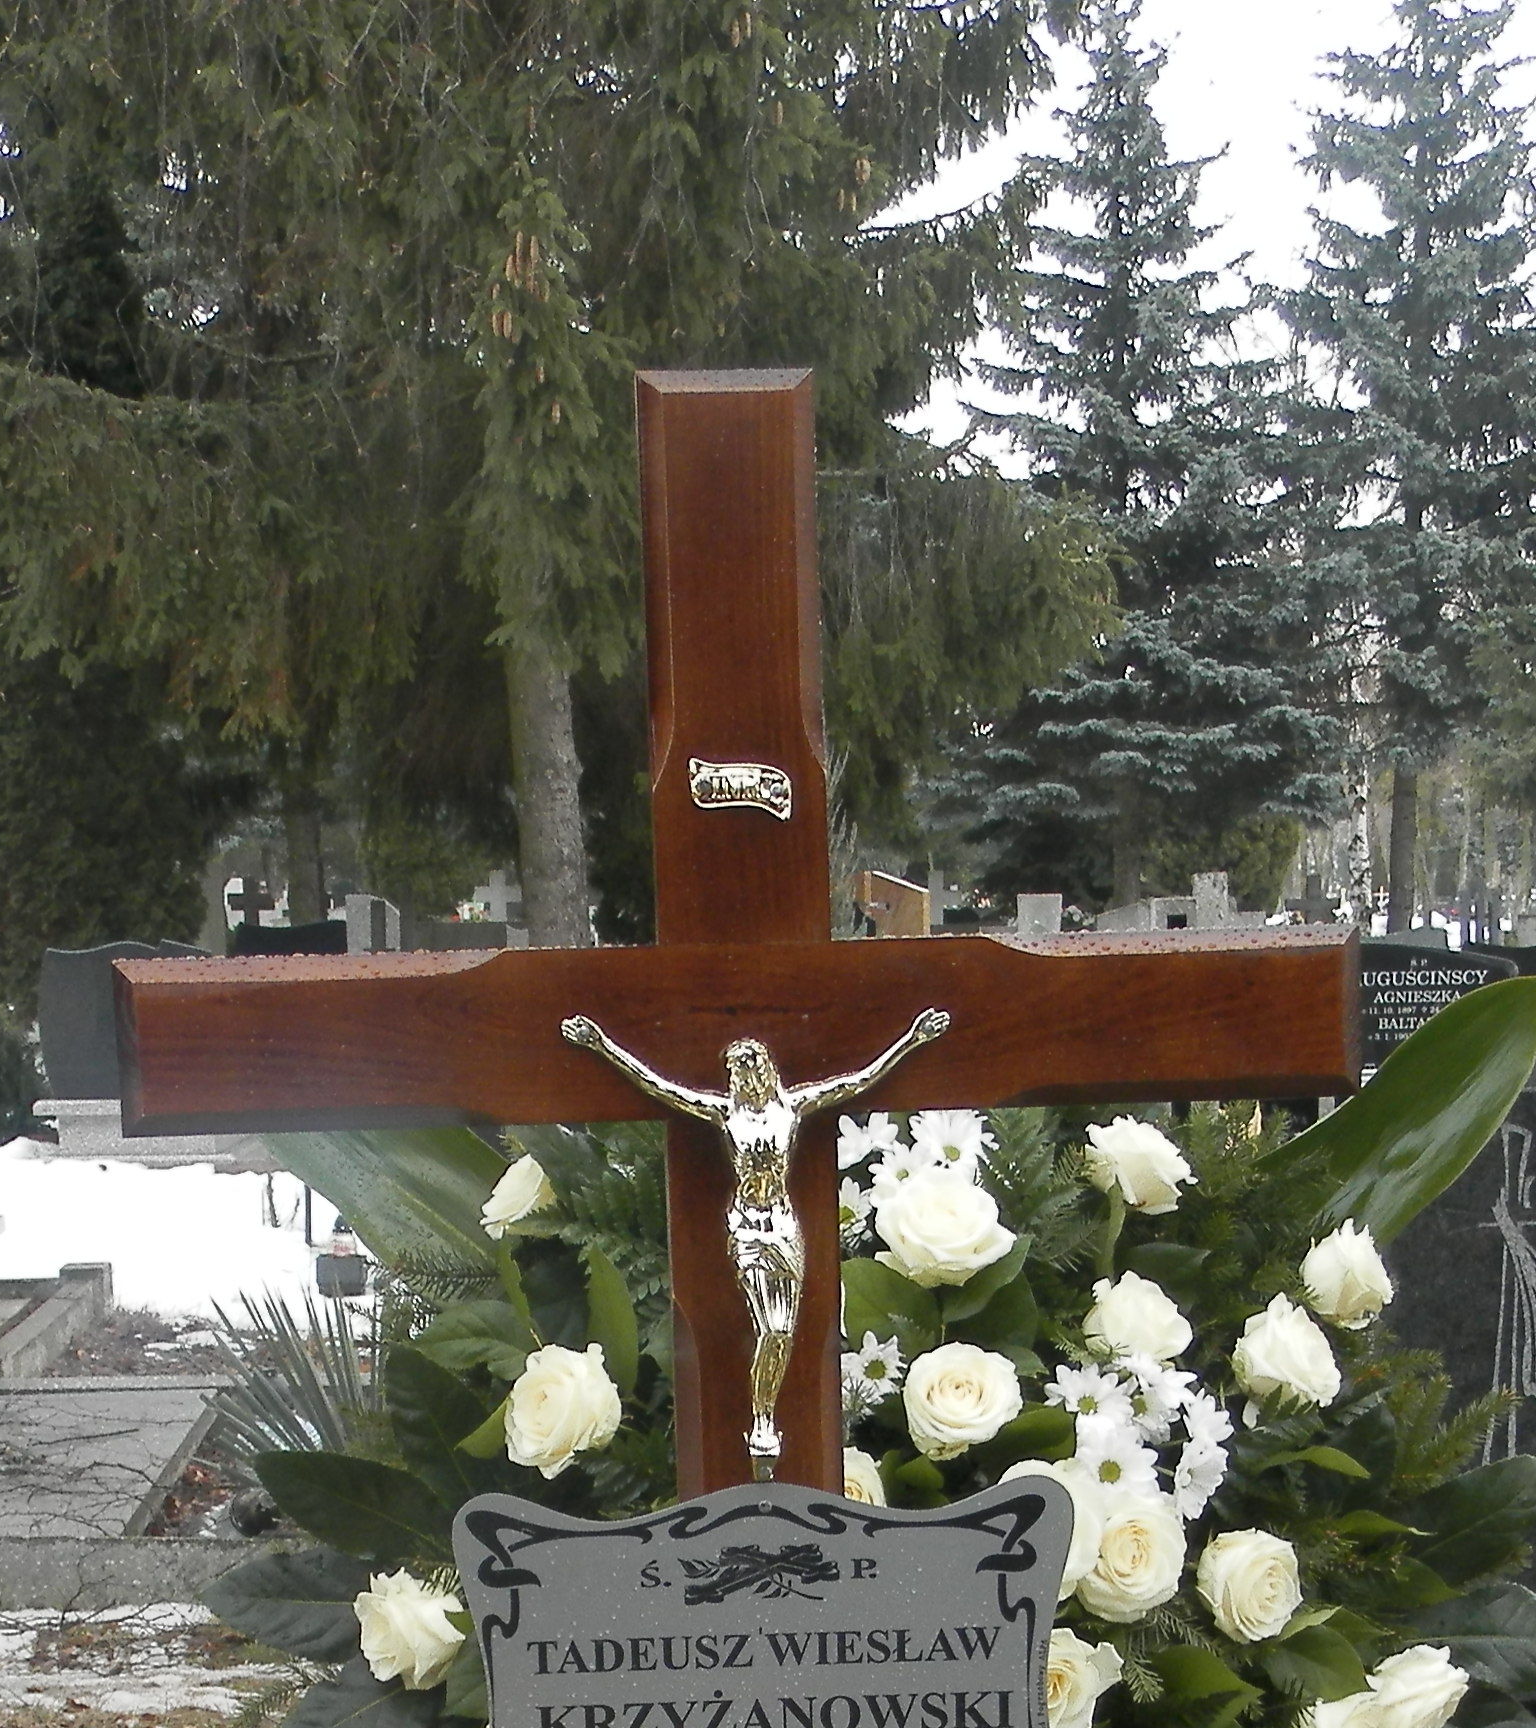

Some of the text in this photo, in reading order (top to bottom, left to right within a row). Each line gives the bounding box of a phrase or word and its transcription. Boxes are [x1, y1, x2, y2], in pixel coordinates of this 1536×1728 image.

[1360, 967, 1488, 987] UGUŚCIŃSCY
[1374, 990, 1462, 1004] AGNIESZKA
[1378, 1016, 1431, 1031] BALTA
[640, 1557, 879, 1588] Ś. P.
[526, 1624, 1003, 1676] TADEUSZ WIESŁAW
